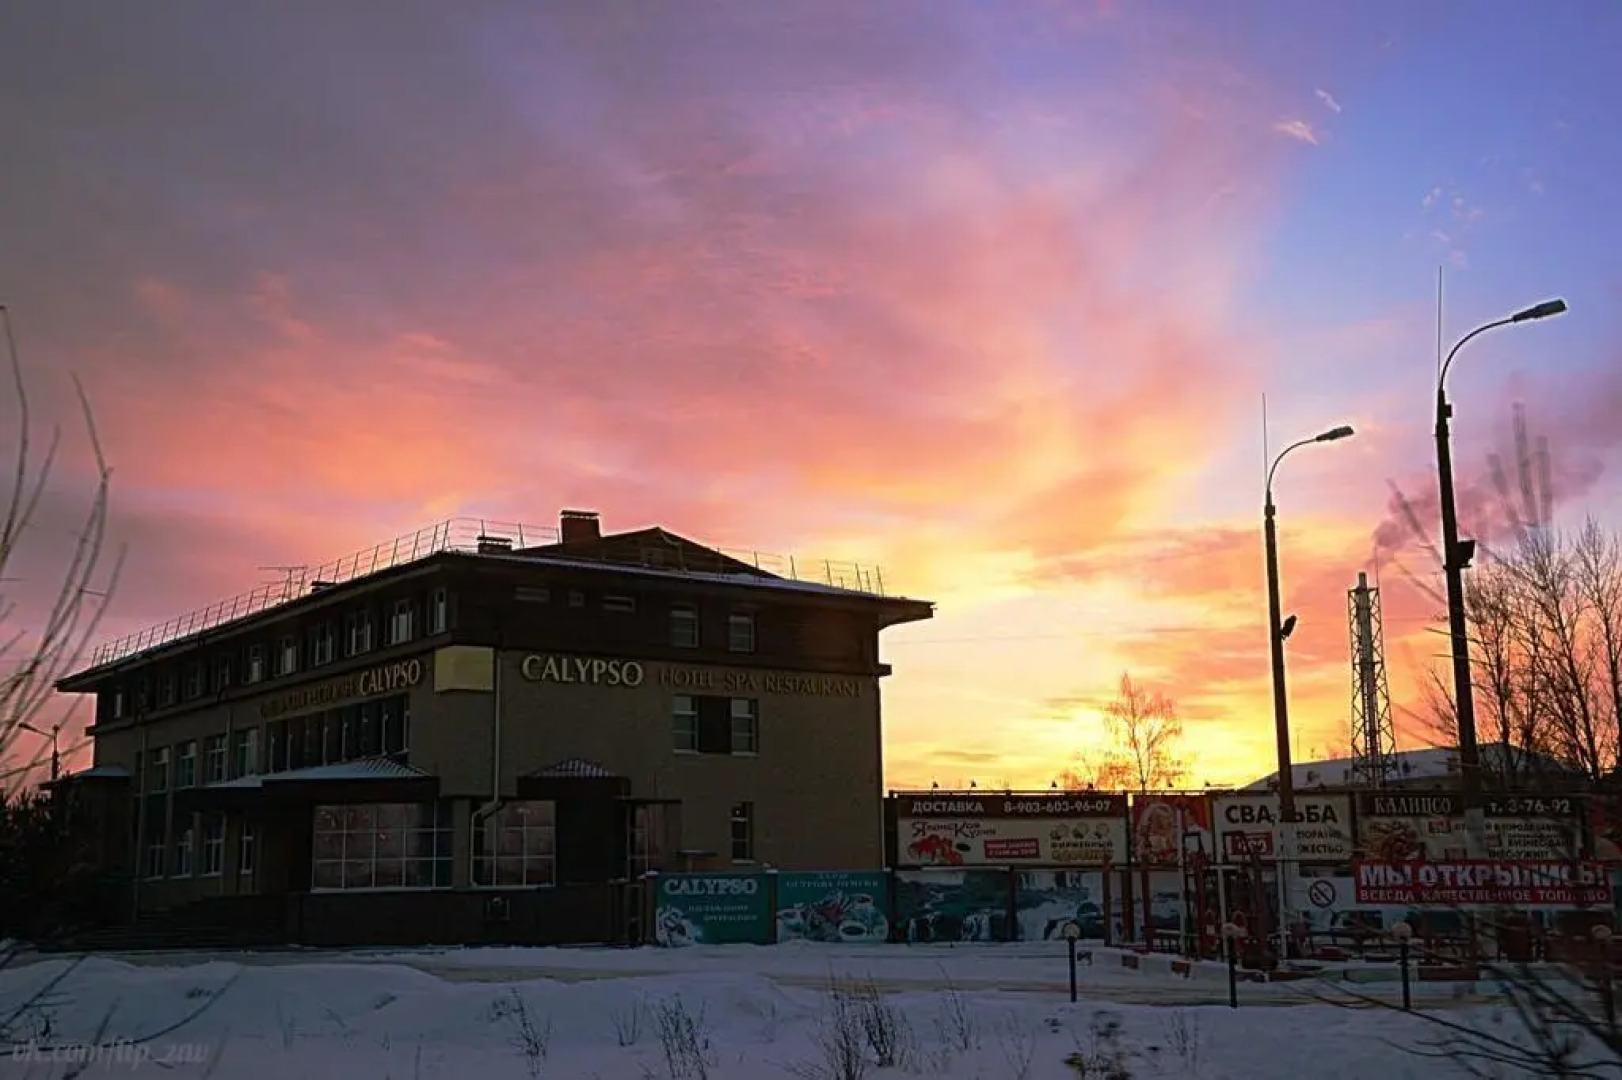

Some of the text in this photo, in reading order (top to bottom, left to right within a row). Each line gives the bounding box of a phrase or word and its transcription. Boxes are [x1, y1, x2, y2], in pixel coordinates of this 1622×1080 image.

[359, 658, 421, 696] CALYPSO
[521, 654, 645, 687] CALYPSO
[658, 668, 714, 689] HOTEL
[723, 671, 759, 691] SPA
[911, 800, 1112, 813] ДОСТАВКА 8-903-603-96-07
[1225, 804, 1338, 823] СВАЬБА
[1507, 799, 1572, 813] 3-76-92
[1360, 864, 1412, 886] МЫ
[664, 878, 758, 895] CALYPSO
[1359, 889, 1413, 901] ВСЕГДА
[1538, 889, 1607, 900] ТОПЛВО
